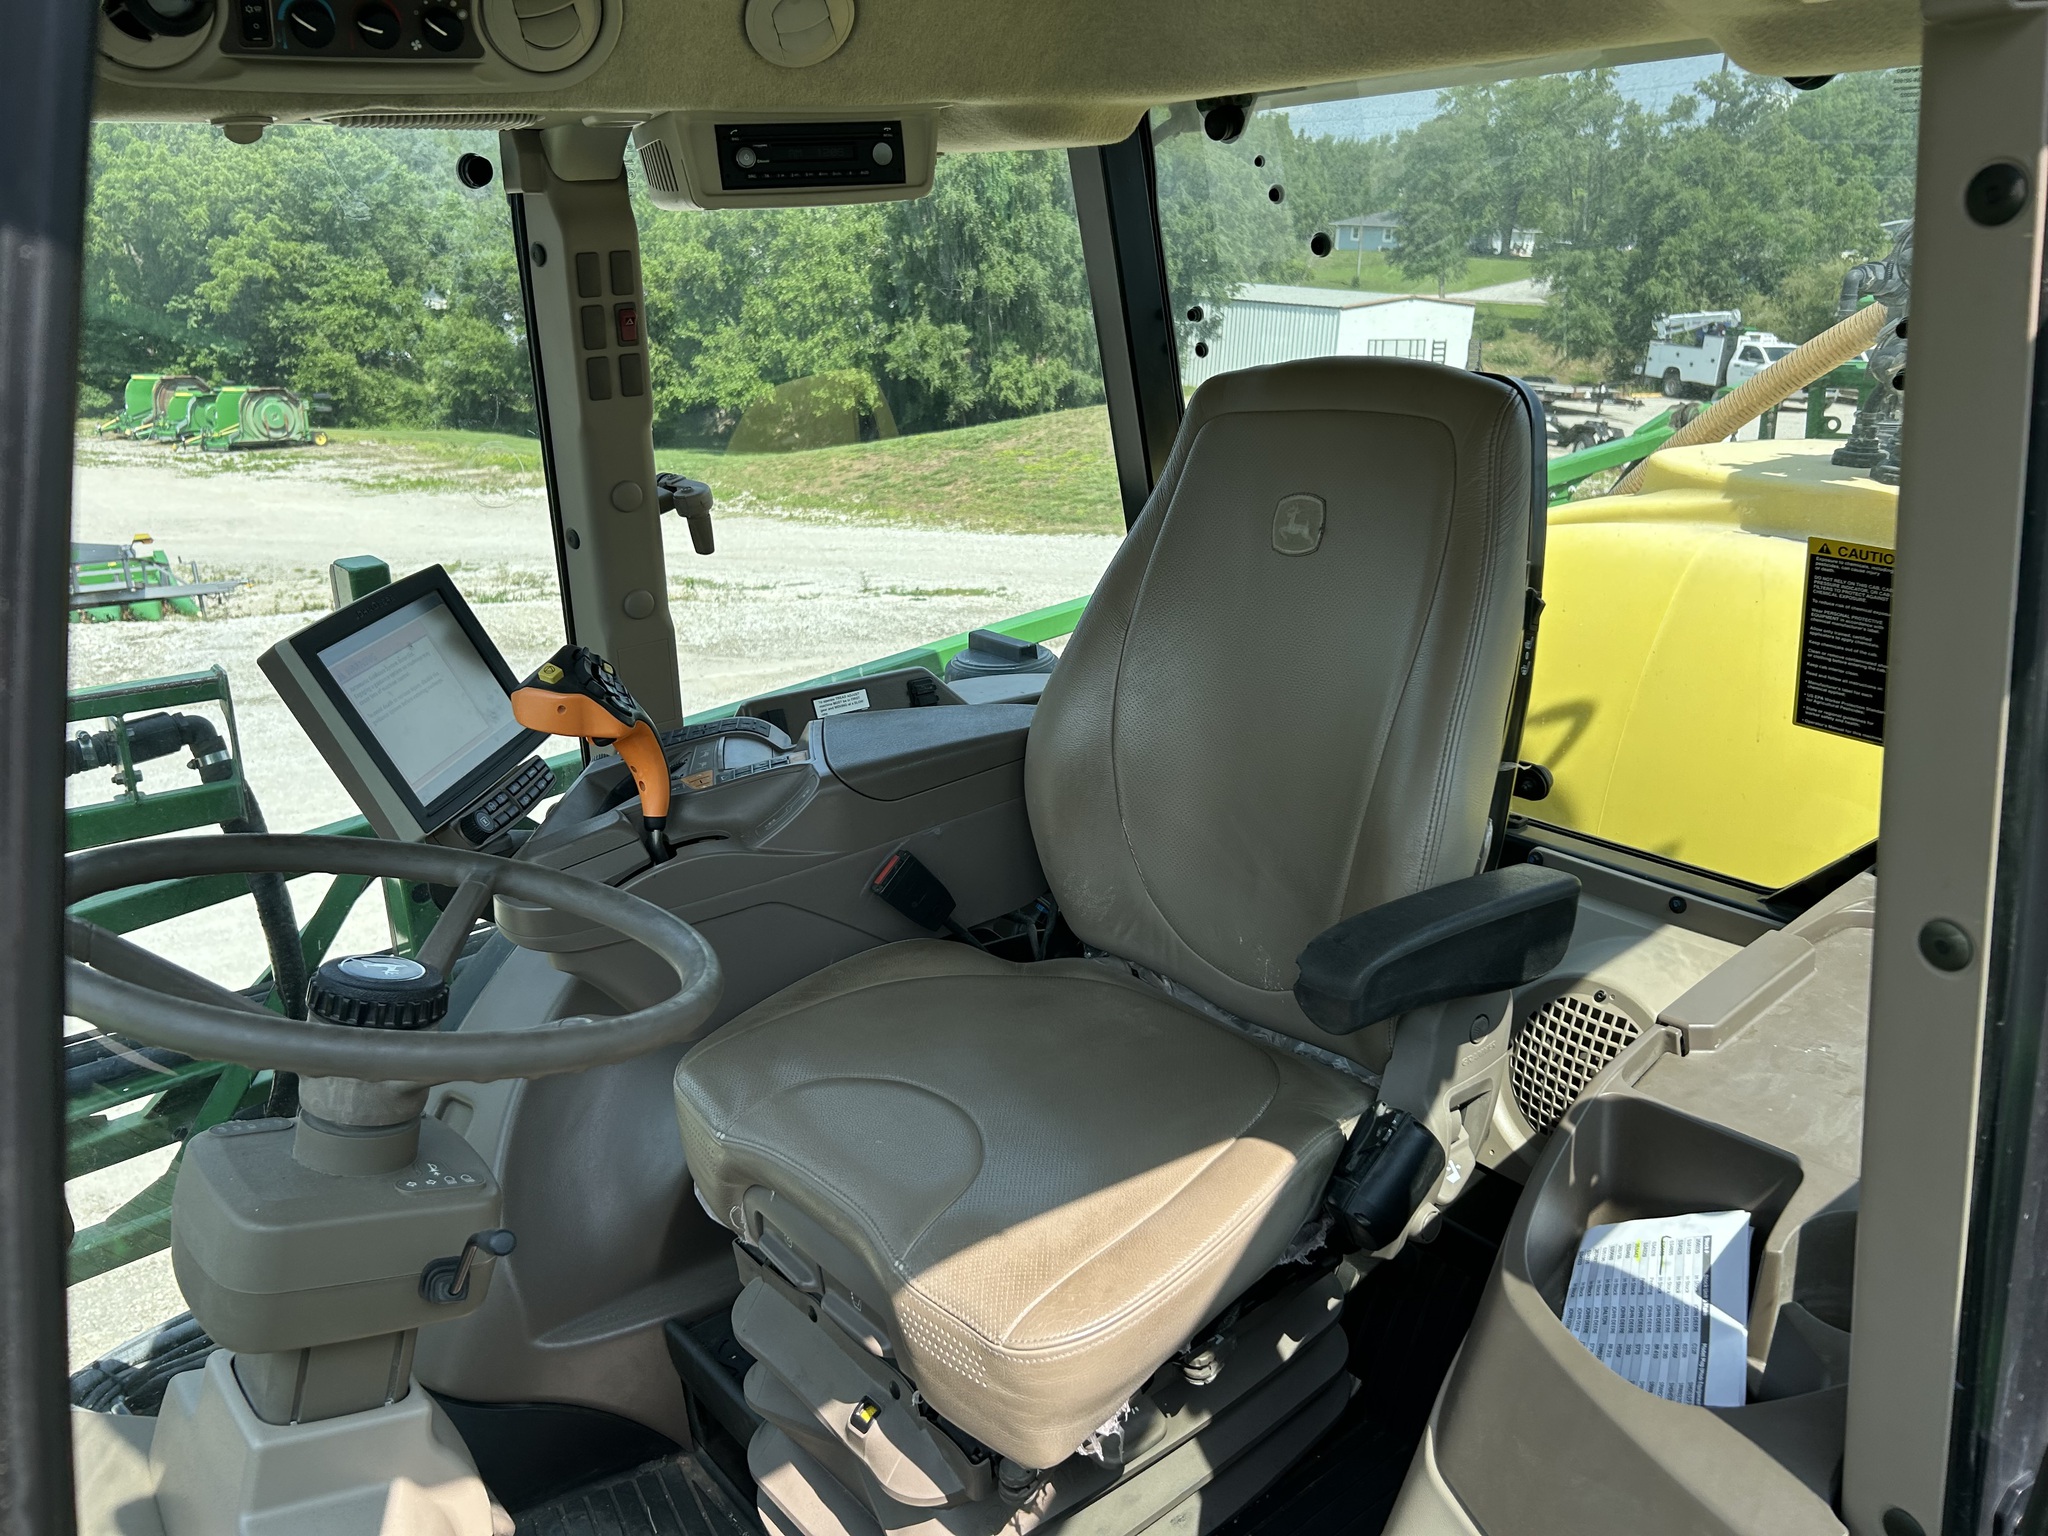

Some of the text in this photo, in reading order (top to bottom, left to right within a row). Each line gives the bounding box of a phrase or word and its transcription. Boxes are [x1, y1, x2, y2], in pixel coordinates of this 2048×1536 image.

[1838, 546, 1894, 564] CAUTIO
[1814, 580, 1840, 588] PRESSURE
[1813, 589, 1838, 598] CHEMICAL
[1842, 590, 1865, 598] PROTECT
[1866, 594, 1889, 602] AGAINST
[1811, 612, 1839, 621] EQUIPMENT
[1824, 610, 1850, 619] PERSONAL
[1851, 616, 1883, 625] PROTECTIVE
